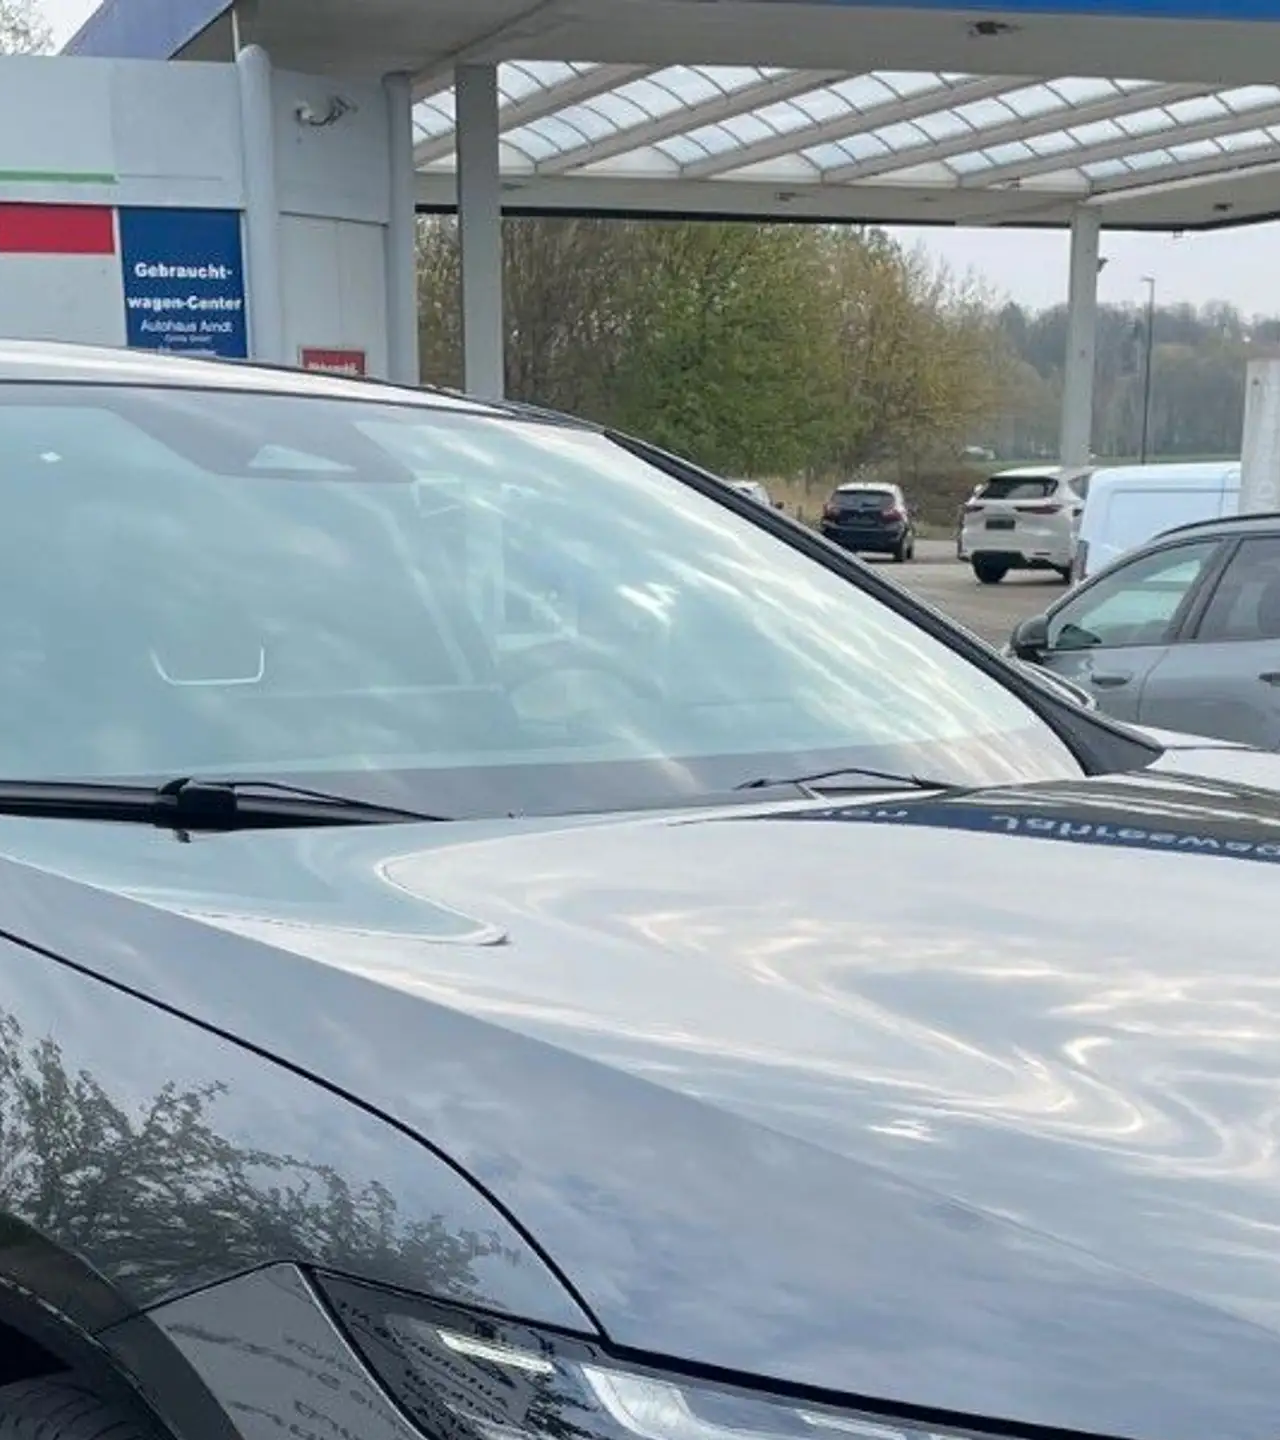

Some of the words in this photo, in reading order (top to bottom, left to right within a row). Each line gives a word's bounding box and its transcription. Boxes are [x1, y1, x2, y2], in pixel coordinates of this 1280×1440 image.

[134, 261, 233, 280] Gebraucht-
[126, 295, 242, 312] wagen-Center
[140, 319, 198, 333] Autohaus
